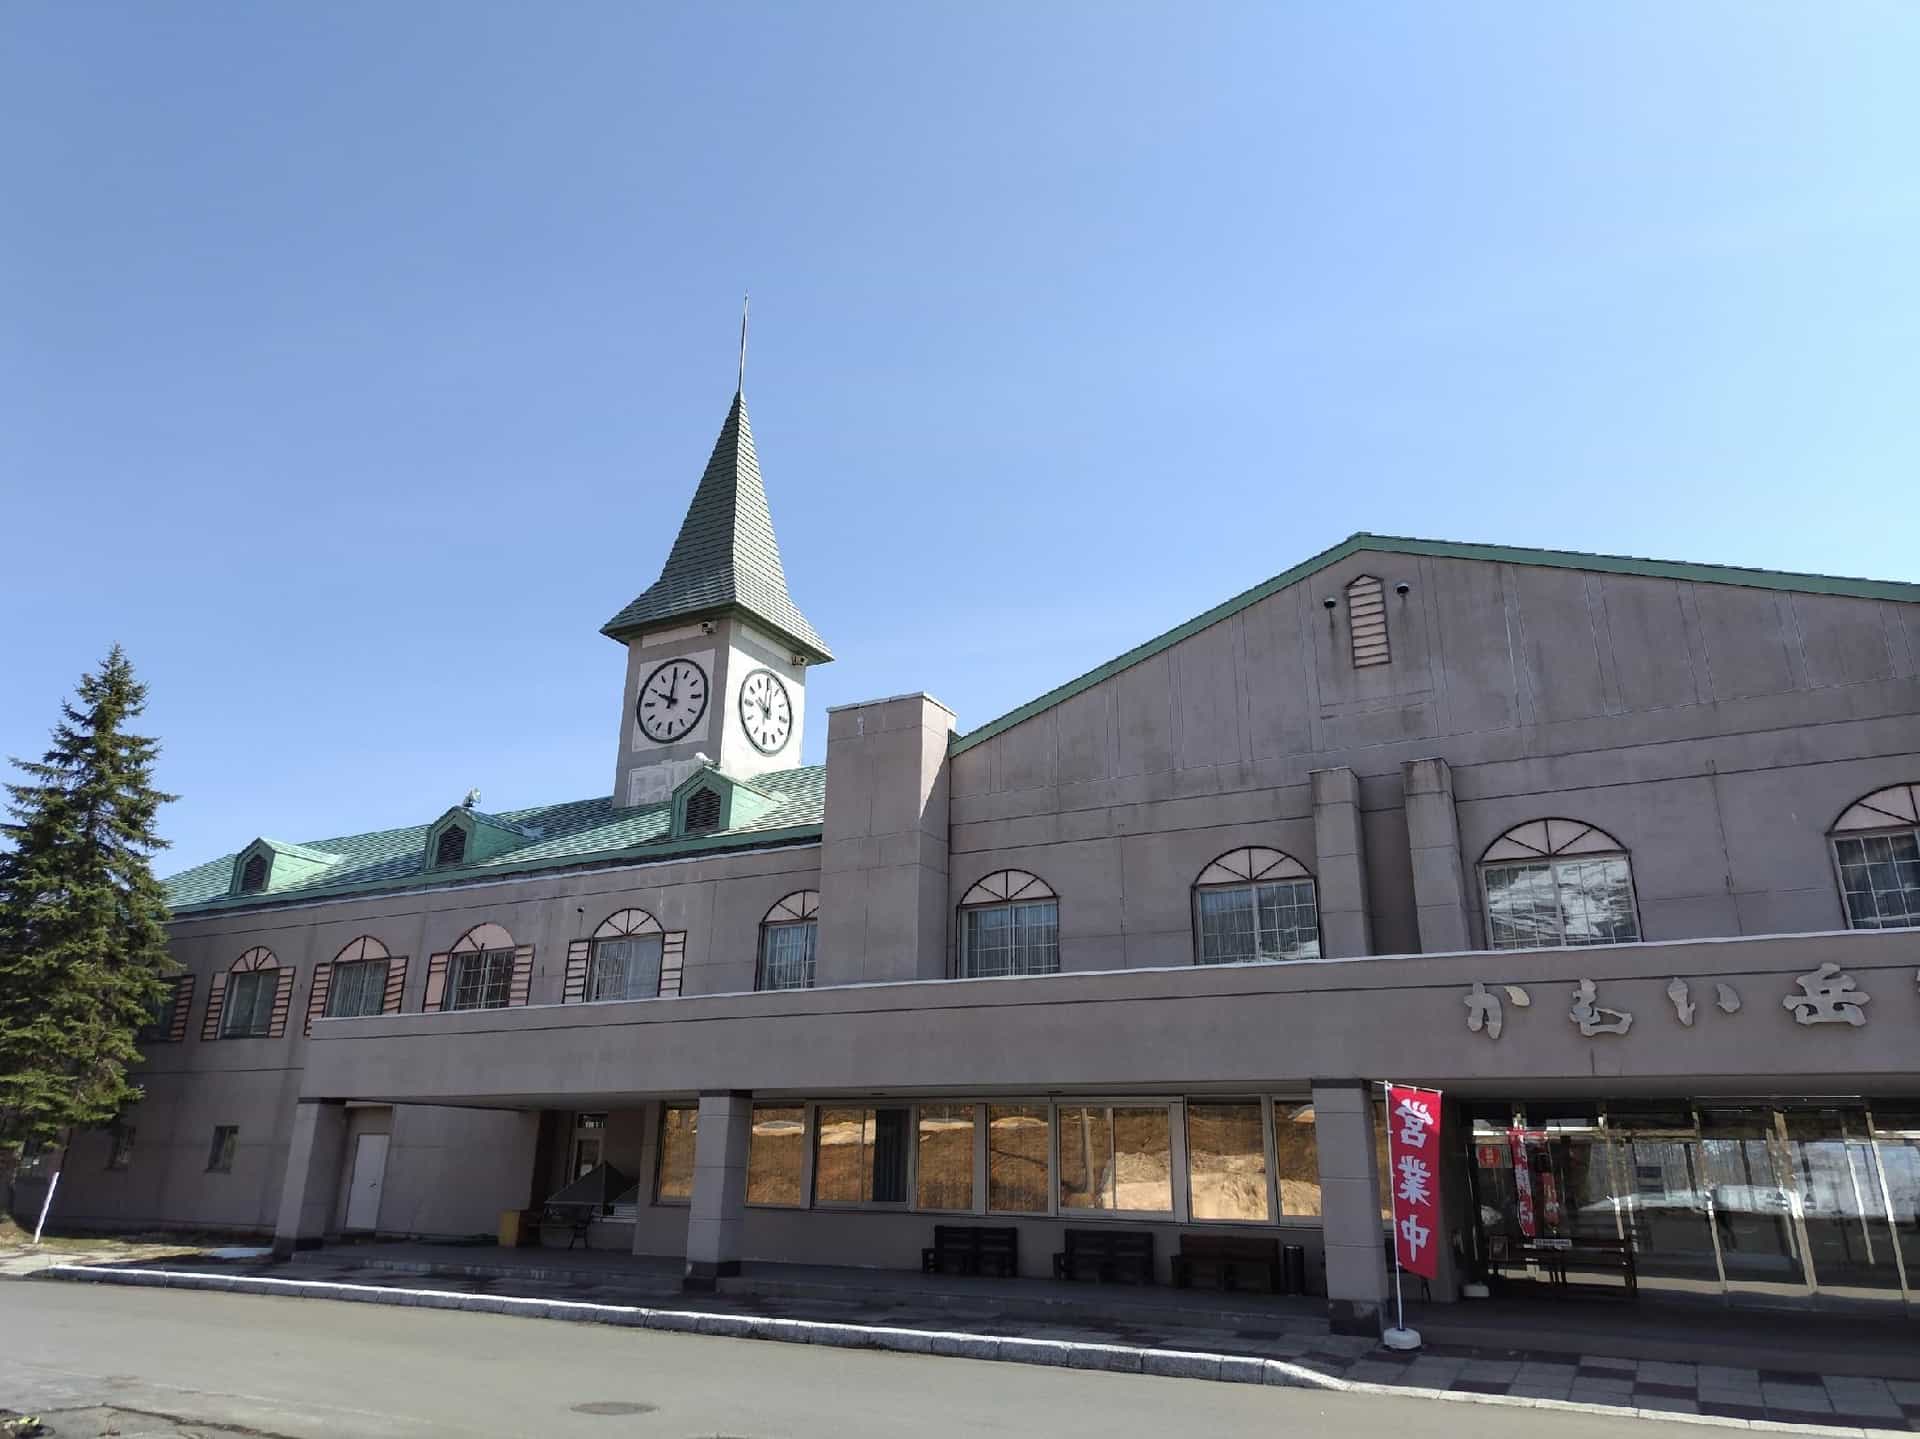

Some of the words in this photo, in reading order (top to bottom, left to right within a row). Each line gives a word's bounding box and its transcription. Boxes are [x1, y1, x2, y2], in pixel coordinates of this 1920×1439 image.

[1463, 962, 1920, 1040] かむい岳
[1394, 1098, 1434, 1262] 営業中
